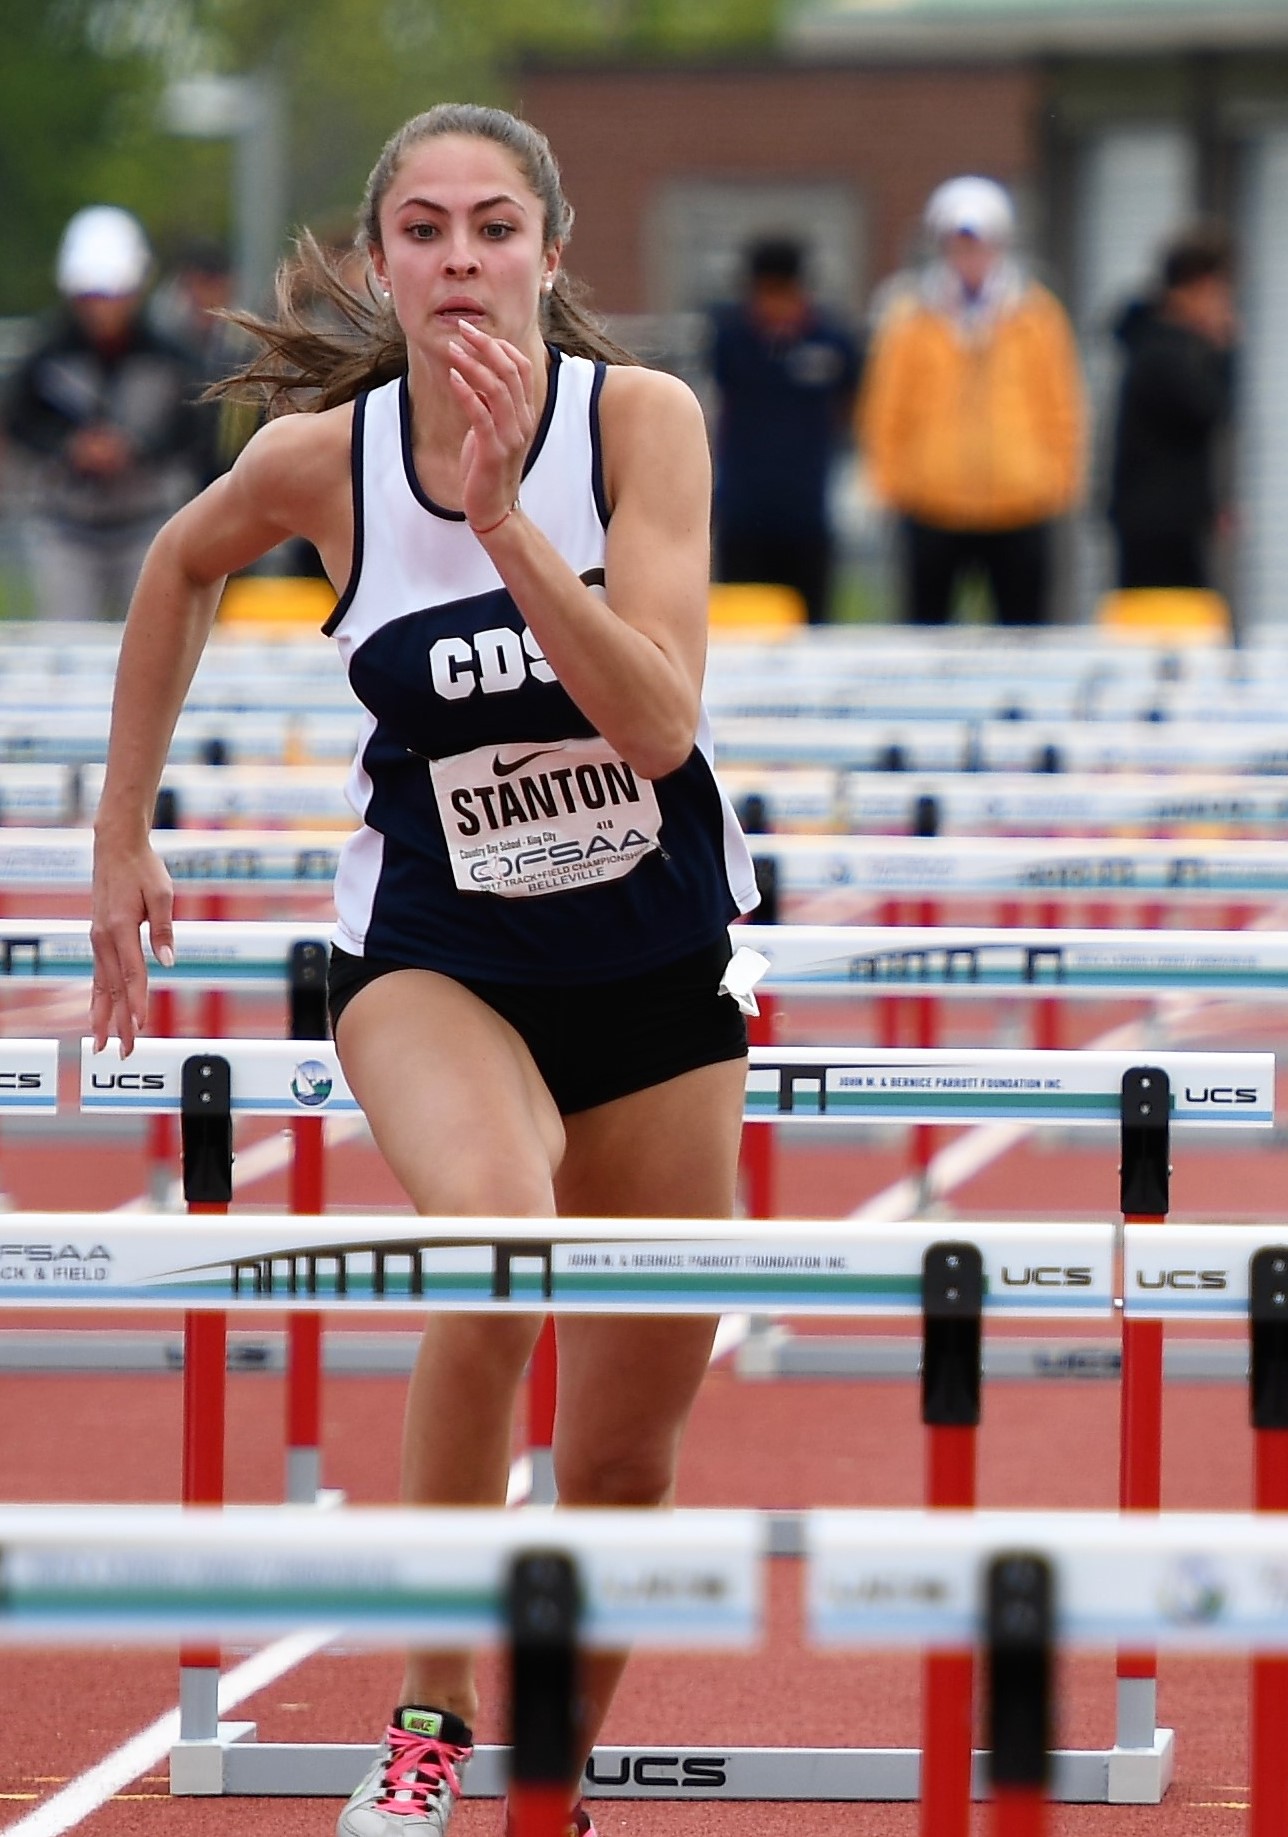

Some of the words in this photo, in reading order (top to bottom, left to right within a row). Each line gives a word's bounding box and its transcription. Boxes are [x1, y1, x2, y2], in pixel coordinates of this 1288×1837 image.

[429, 626, 559, 700] CDS
[450, 761, 641, 836] STANTON
[469, 828, 650, 882] OFSAA
[527, 866, 606, 892] BELLEVILLE
[91, 1072, 165, 1089] UCS
[1185, 1087, 1258, 1103] UCS
[53, 1267, 107, 1281] FIELD
[1001, 1266, 1093, 1287] UCS
[1136, 1270, 1228, 1290] UCS
[585, 1755, 727, 1788] UCS
